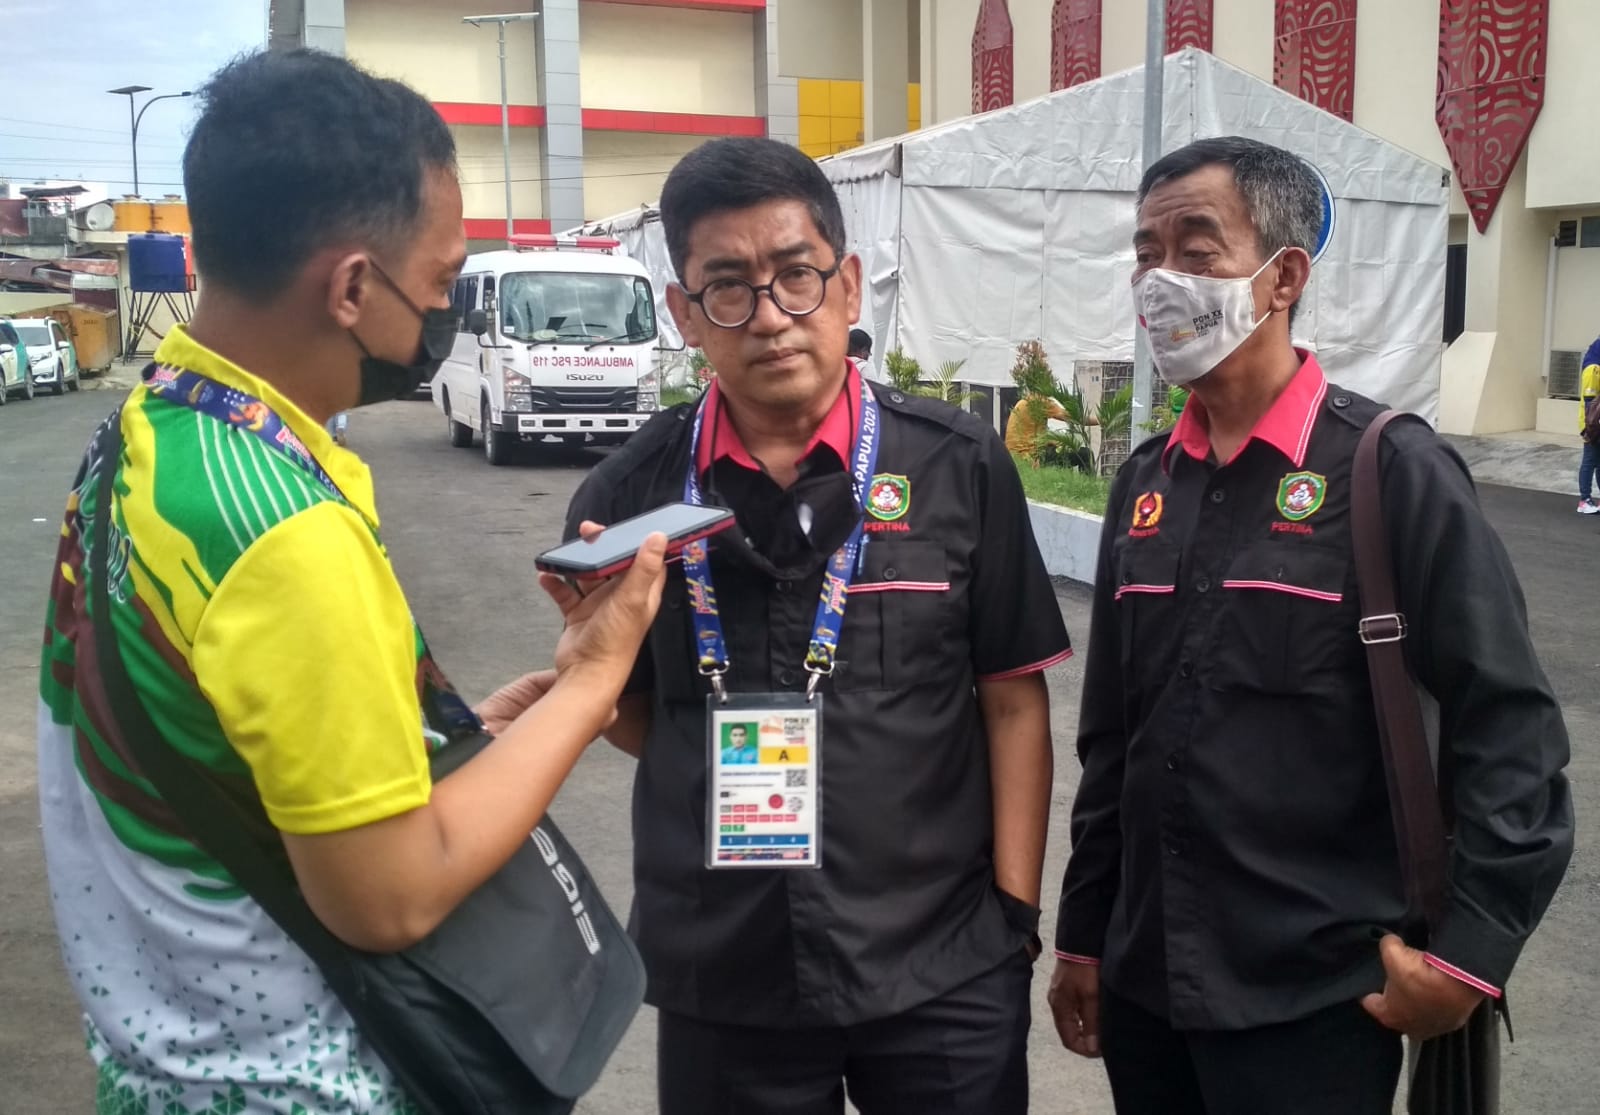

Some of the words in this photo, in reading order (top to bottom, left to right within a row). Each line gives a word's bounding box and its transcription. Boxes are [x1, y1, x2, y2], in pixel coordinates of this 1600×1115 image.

[1195, 321, 1218, 333] PAPUA
[863, 407, 876, 434] 2021
[854, 434, 873, 483] PAPUA
[779, 750, 789, 761] A
[530, 826, 600, 955] EIGE
